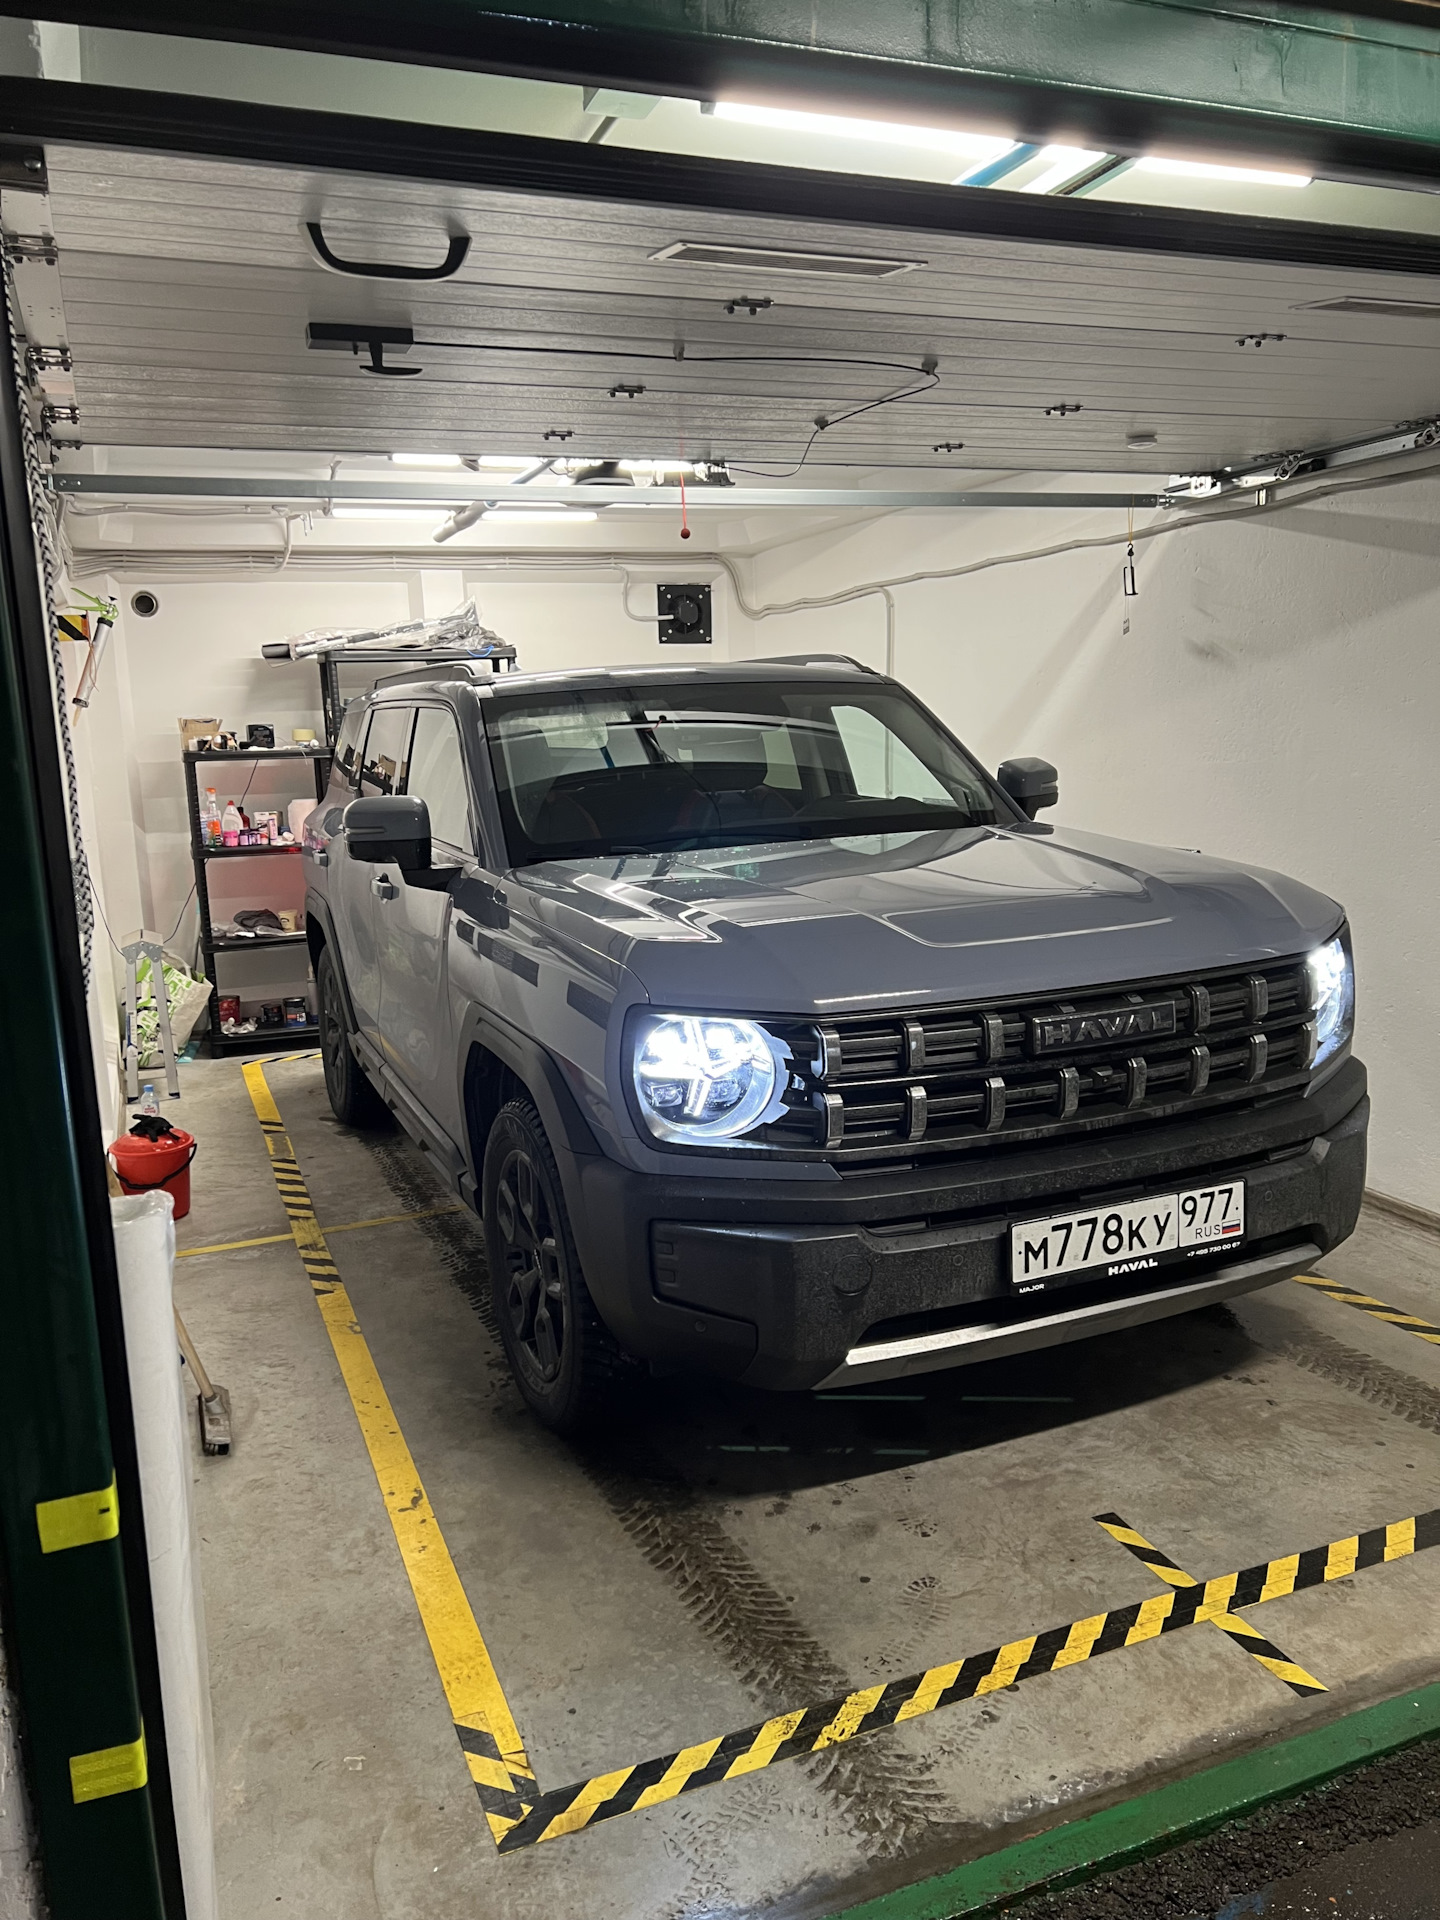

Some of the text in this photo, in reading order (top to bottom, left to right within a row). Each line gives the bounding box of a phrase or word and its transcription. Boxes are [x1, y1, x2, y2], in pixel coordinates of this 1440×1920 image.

[1044, 1010, 1173, 1046] HAVAL
[1181, 1187, 1234, 1227] 977
[1195, 1224, 1221, 1239] RUS
[1108, 1258, 1158, 1276] HAVAL
[1019, 1283, 1045, 1294] MAJOR
